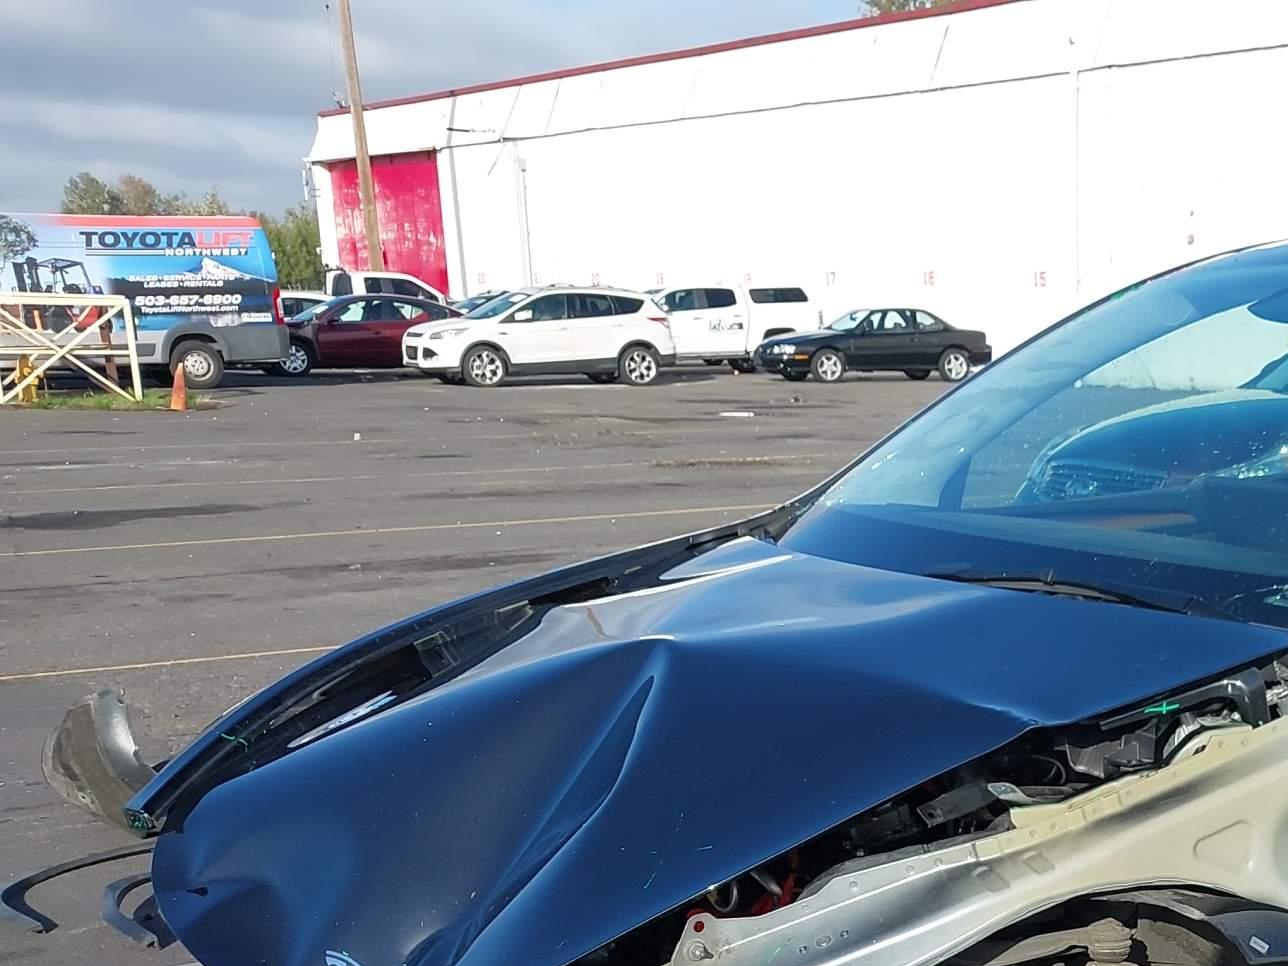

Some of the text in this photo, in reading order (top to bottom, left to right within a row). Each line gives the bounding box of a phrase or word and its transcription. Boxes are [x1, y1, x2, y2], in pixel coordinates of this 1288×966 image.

[825, 271, 836, 286] 17
[923, 270, 935, 286] 16
[1034, 271, 1047, 288] 15
